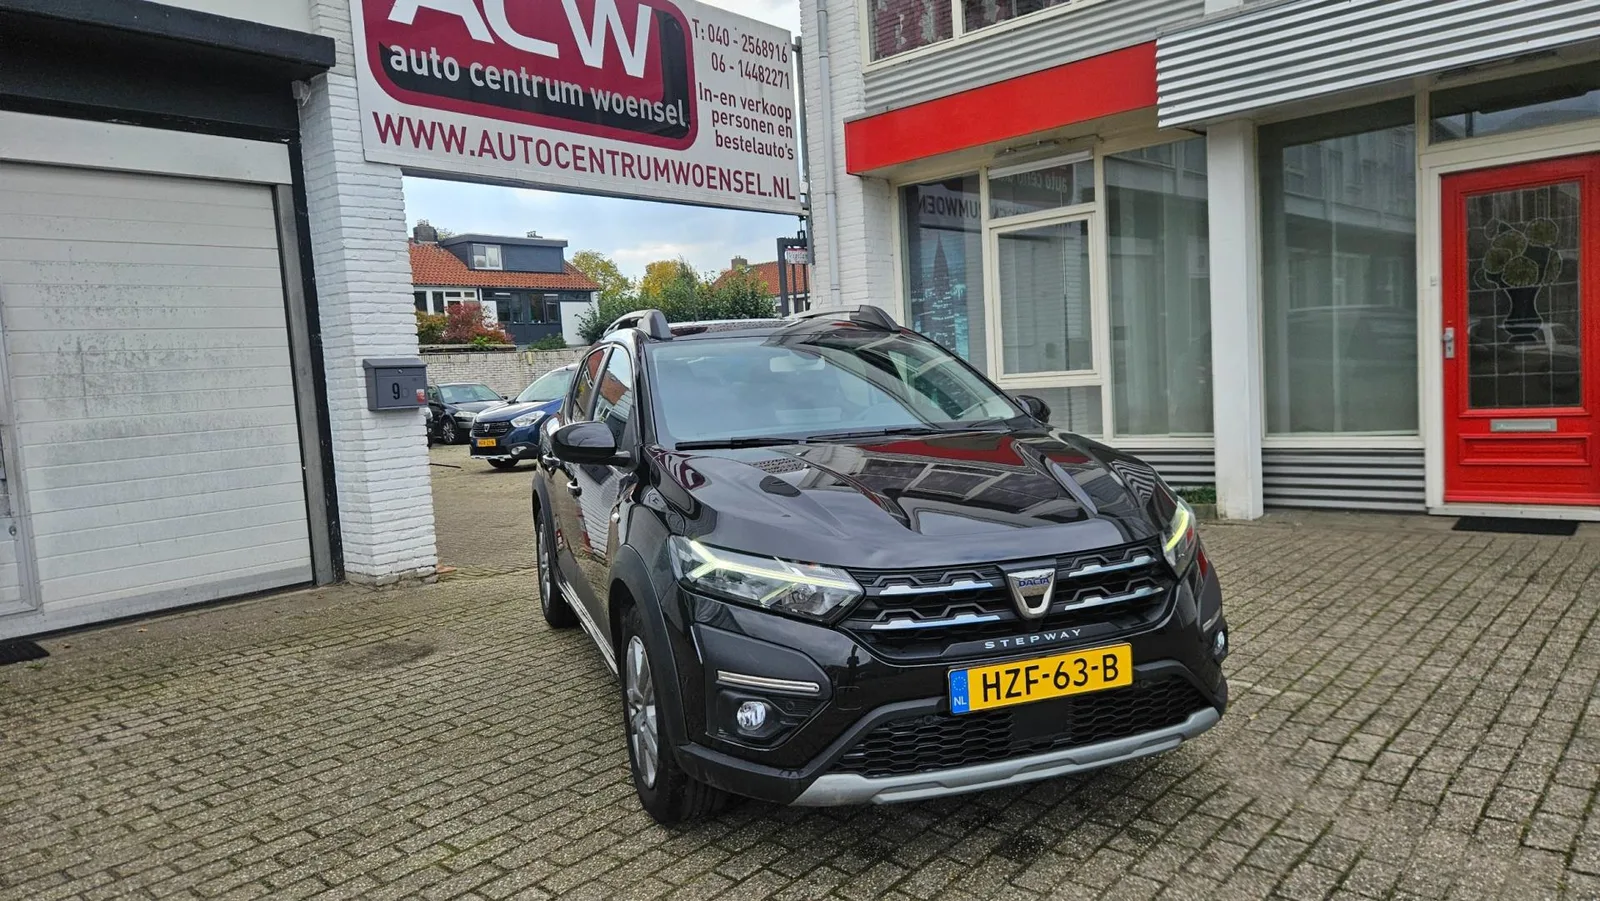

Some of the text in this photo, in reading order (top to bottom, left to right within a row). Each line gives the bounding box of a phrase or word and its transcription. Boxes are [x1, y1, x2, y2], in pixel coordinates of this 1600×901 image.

[692, 18, 705, 40] T:
[707, 23, 730, 47] 040
[741, 33, 788, 64] 2568916
[388, 44, 686, 128] auto centrum woensel
[711, 52, 726, 73] 06
[738, 59, 790, 90] 14482271
[698, 82, 792, 124] In-en verkoop
[711, 109, 793, 139] personen en
[371, 111, 796, 201] WWW.AUTOCENTRUMWOENSEL.NL
[714, 129, 794, 160] bestelauto's
[1018, 577, 1050, 587] DACIA
[984, 628, 1081, 649] STEPWAY
[953, 653, 1119, 707] NL HZF-63-B
